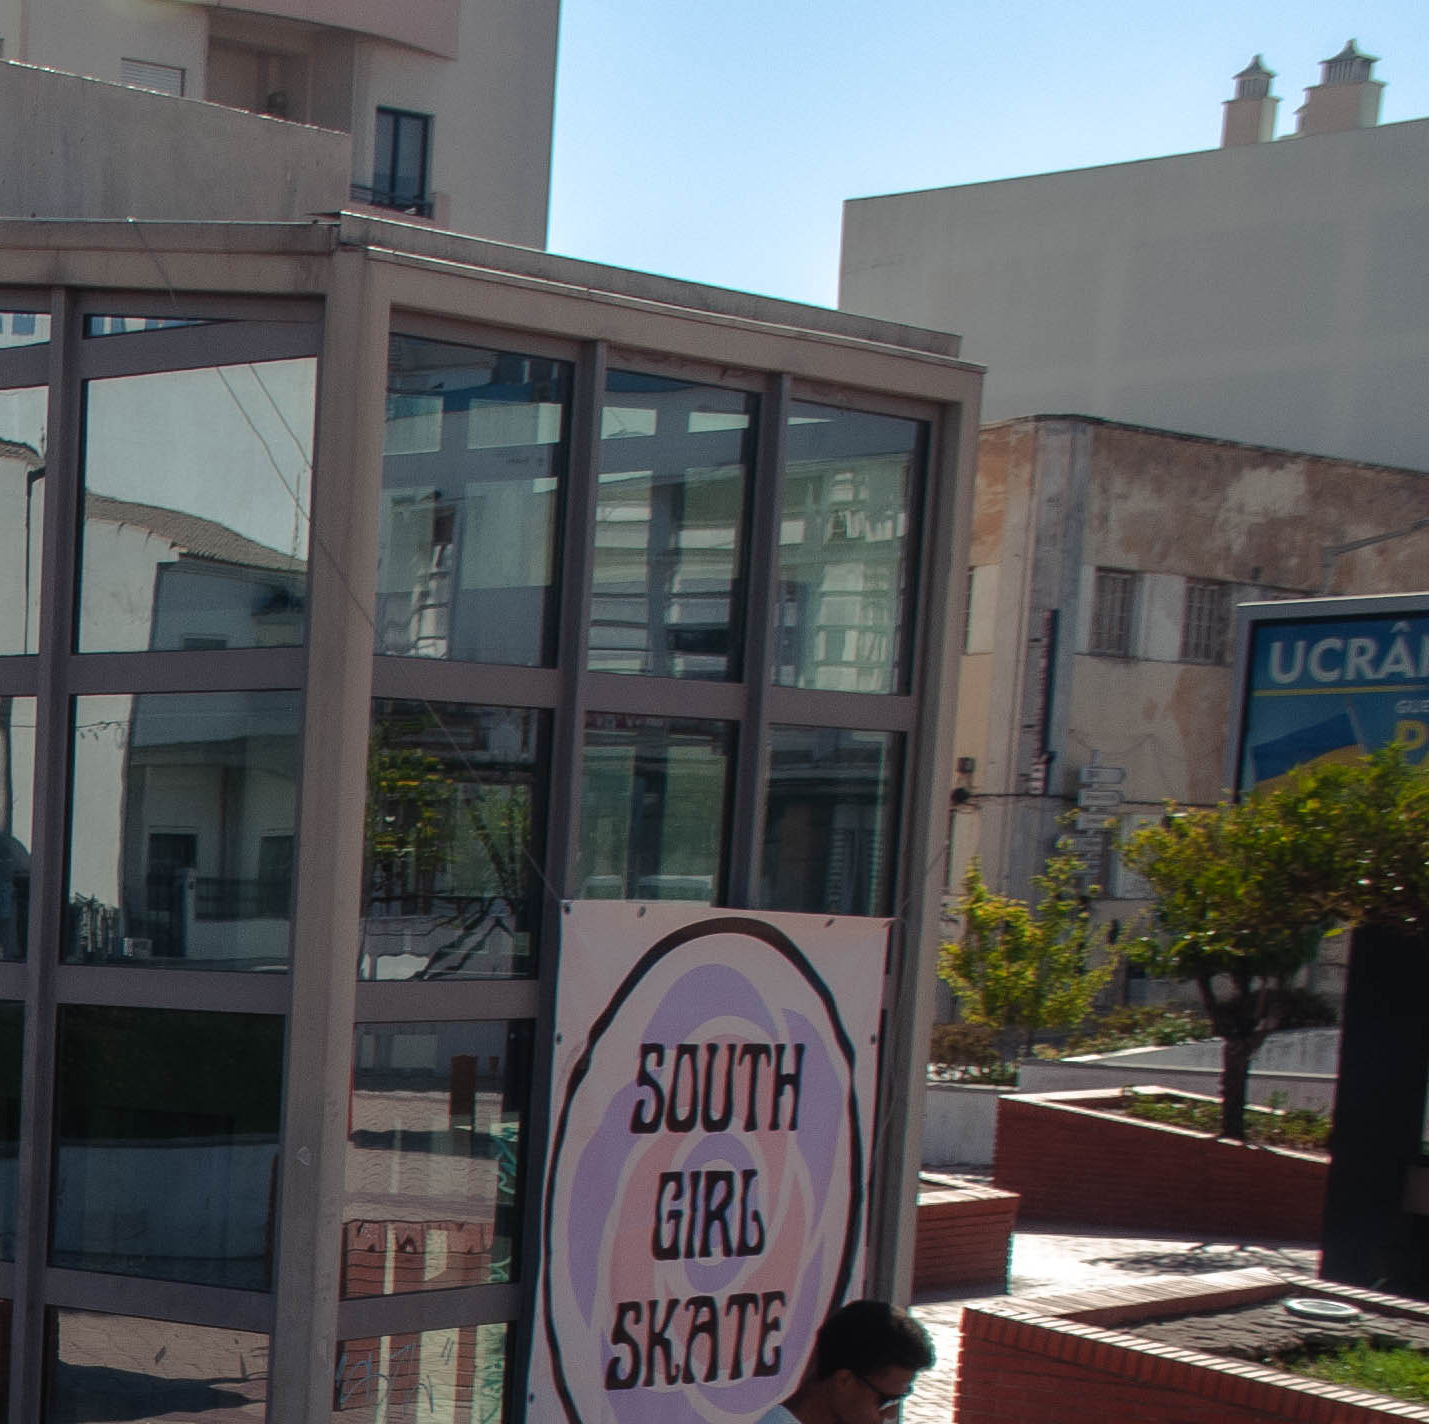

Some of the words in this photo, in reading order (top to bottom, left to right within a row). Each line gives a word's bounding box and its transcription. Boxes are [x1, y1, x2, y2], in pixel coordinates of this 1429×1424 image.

[630, 1042, 806, 1134] SOUTH
[652, 1168, 765, 1261] GIRL
[604, 1290, 787, 1390] SKATE
